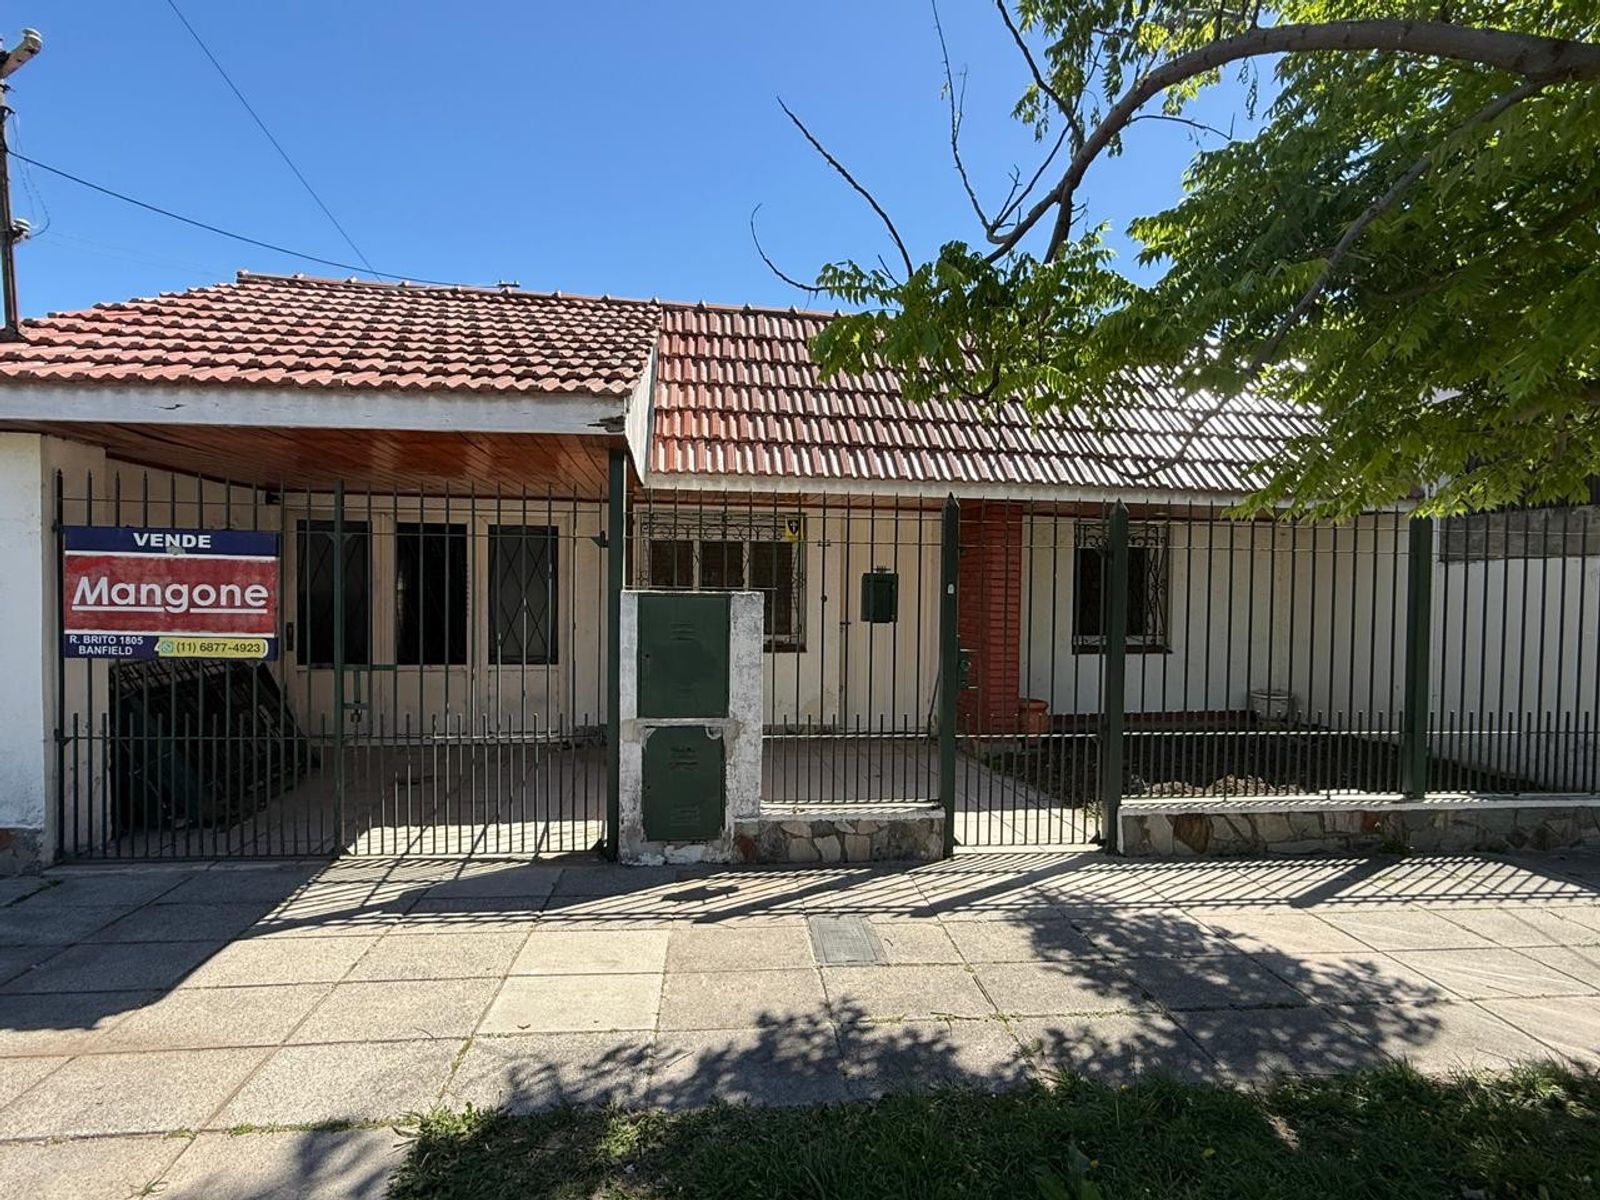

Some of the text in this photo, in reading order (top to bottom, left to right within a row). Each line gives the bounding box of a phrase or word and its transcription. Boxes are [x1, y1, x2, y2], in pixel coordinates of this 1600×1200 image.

[133, 532, 211, 549] VENDE
[72, 576, 269, 614] Mangone
[69, 635, 80, 644] R.
[83, 635, 117, 645] BRITO
[119, 636, 144, 646] 1805
[176, 640, 261, 653] (11) 6877-4923
[78, 645, 133, 656] BANFIELD
